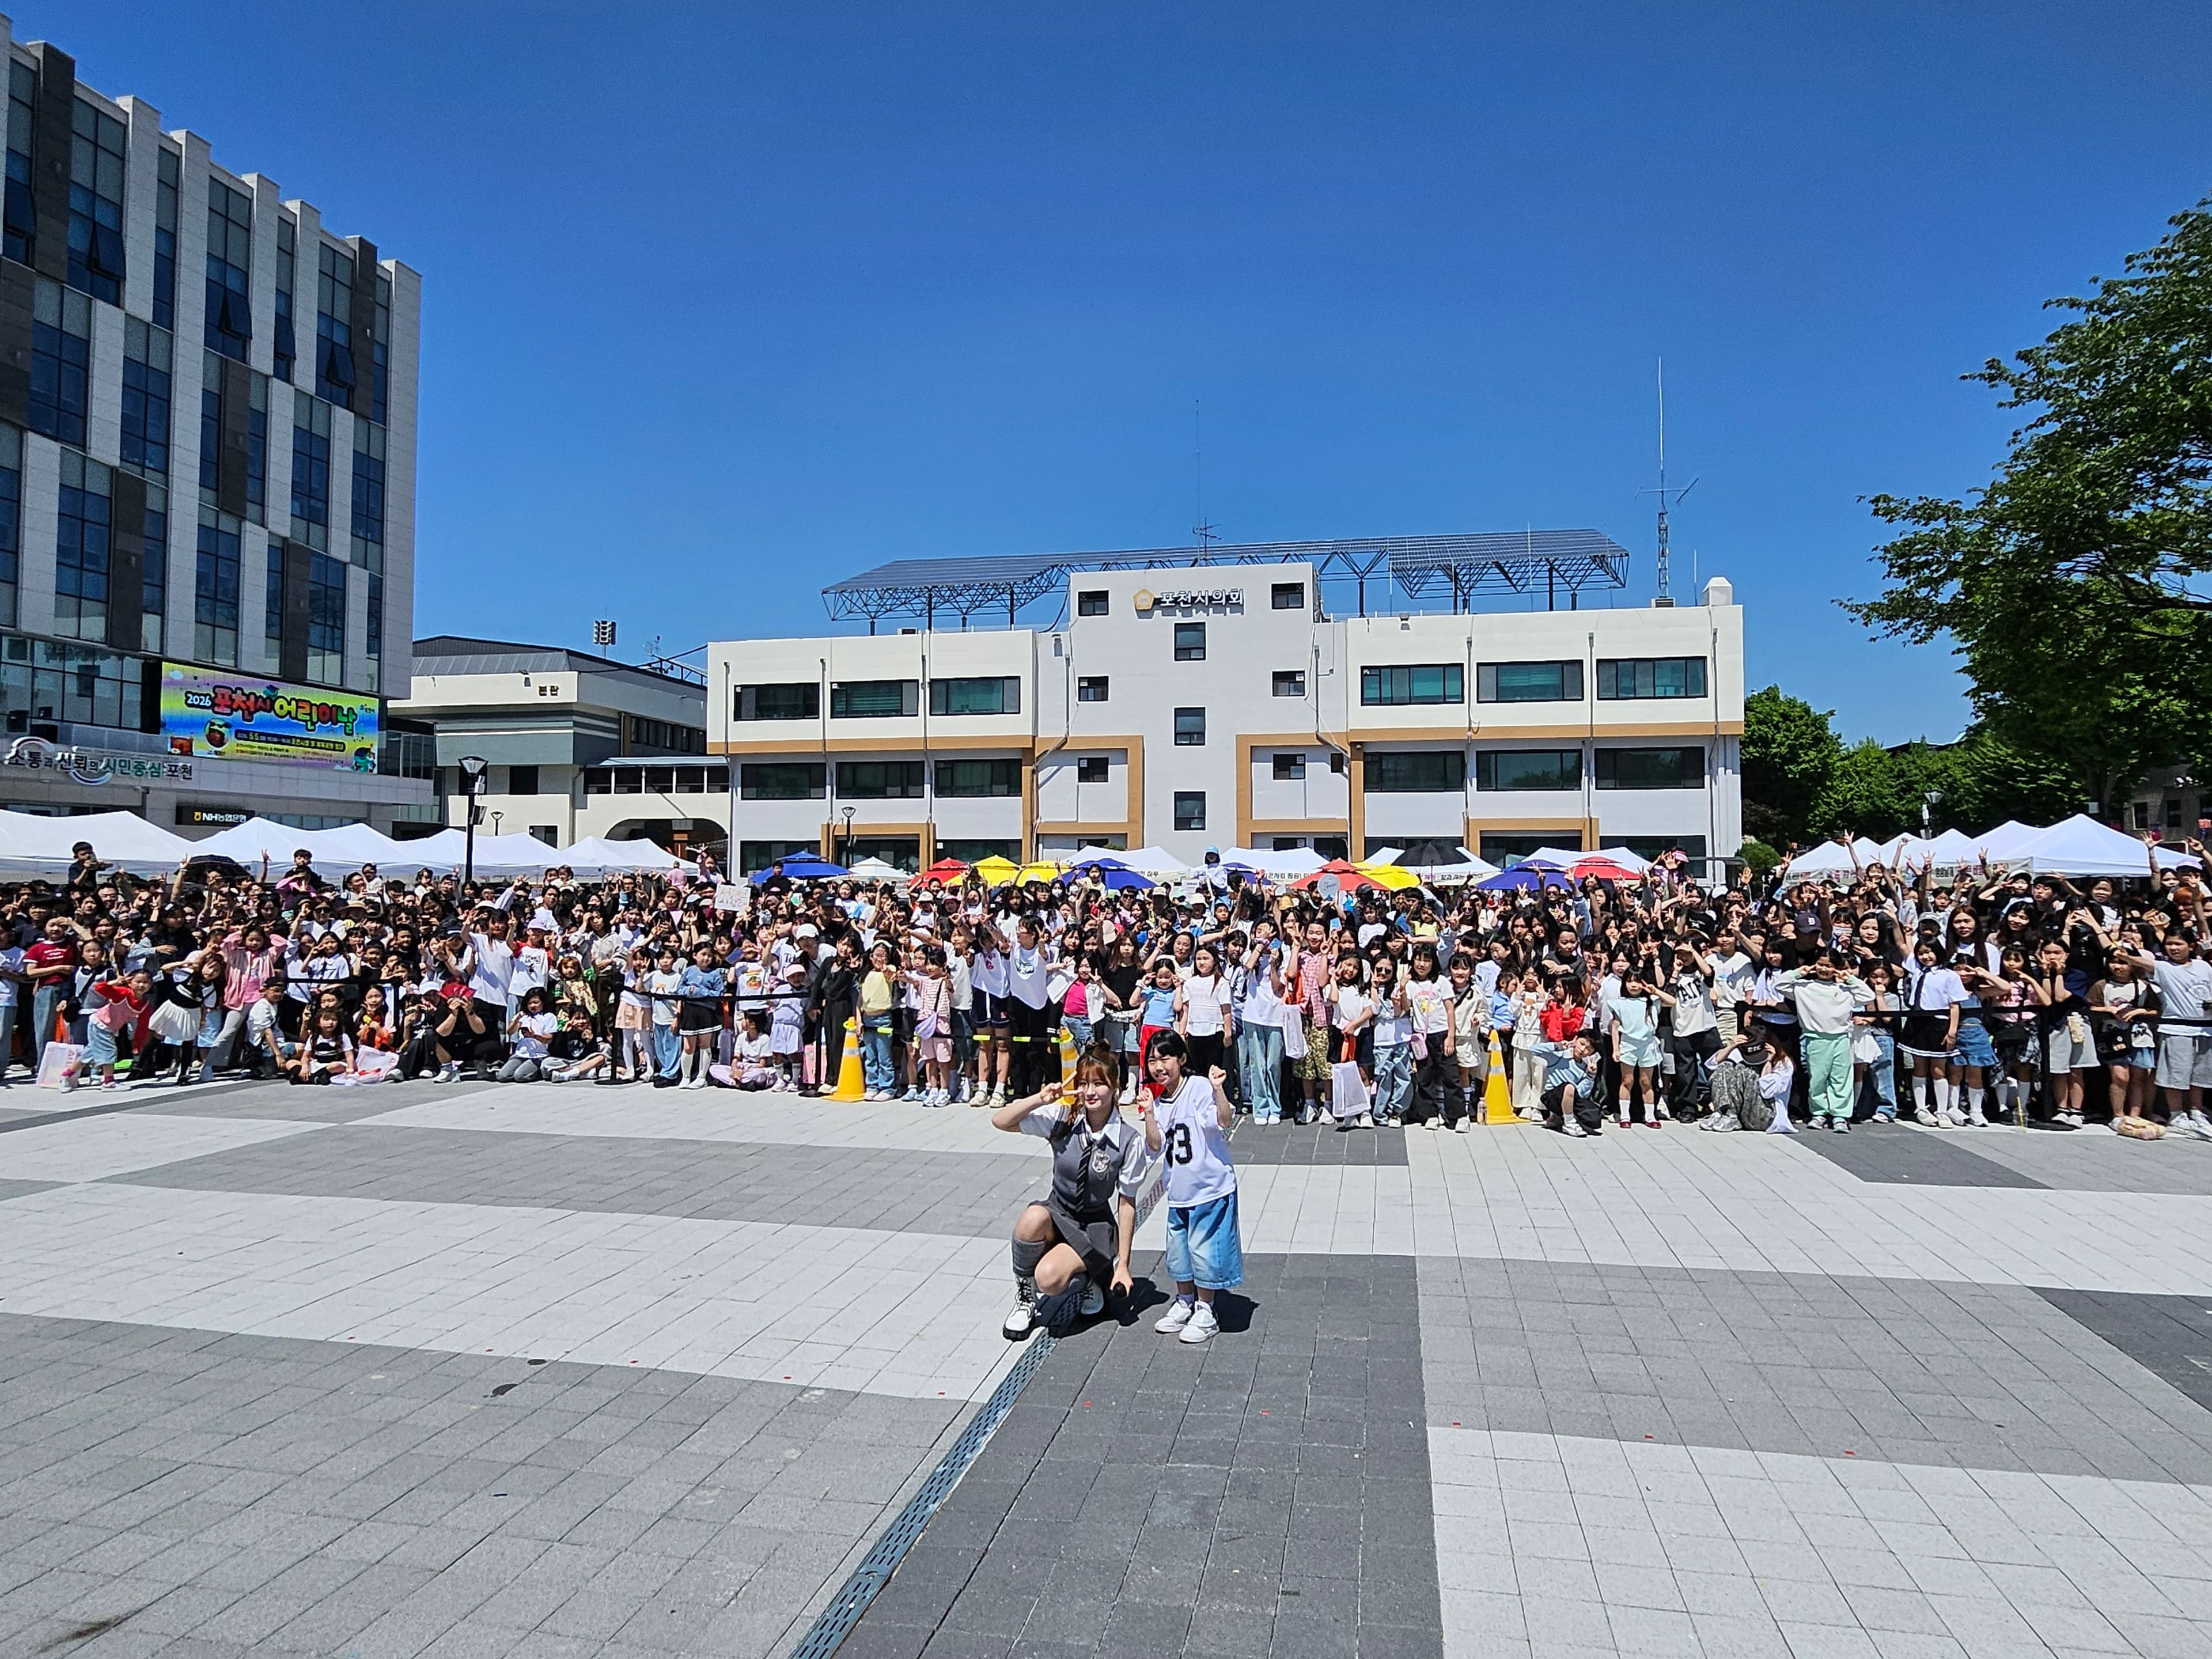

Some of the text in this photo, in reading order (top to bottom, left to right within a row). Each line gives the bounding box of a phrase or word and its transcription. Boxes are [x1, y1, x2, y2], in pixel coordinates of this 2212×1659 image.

[1160, 588, 1244, 607] 포천시의회
[187, 687, 356, 733] 2026 포천시 어린이날
[8, 749, 193, 780] 소통과 신뢰의 시민중심 포천
